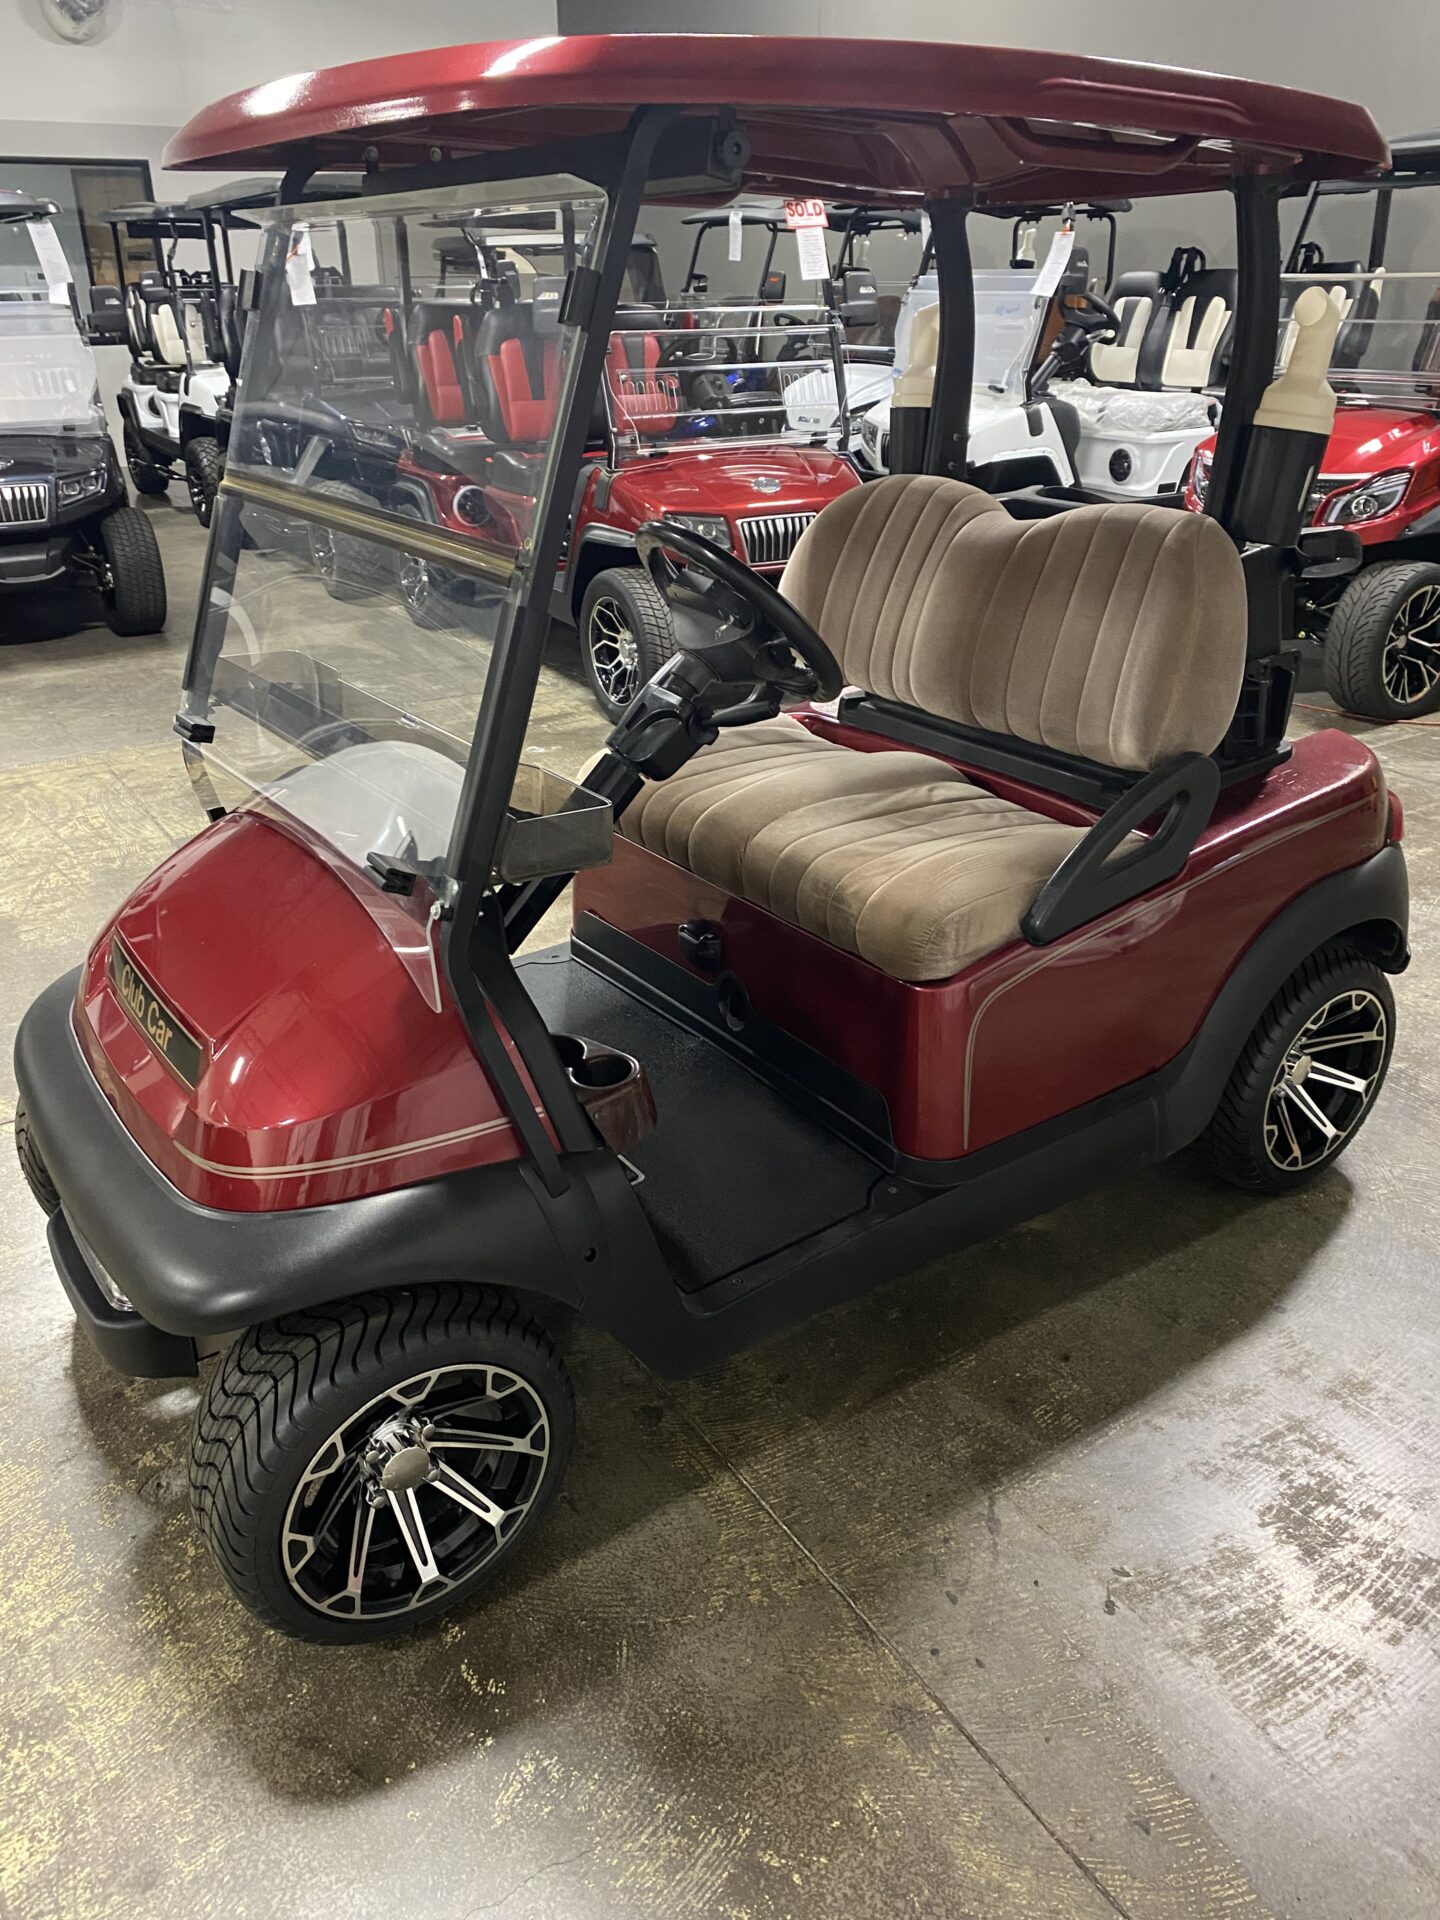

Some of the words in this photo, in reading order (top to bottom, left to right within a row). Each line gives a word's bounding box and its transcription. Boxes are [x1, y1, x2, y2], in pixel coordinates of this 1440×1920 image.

[786, 202, 823, 217] SOLD
[121, 964, 145, 1018] Club
[147, 1001, 173, 1051] Car
